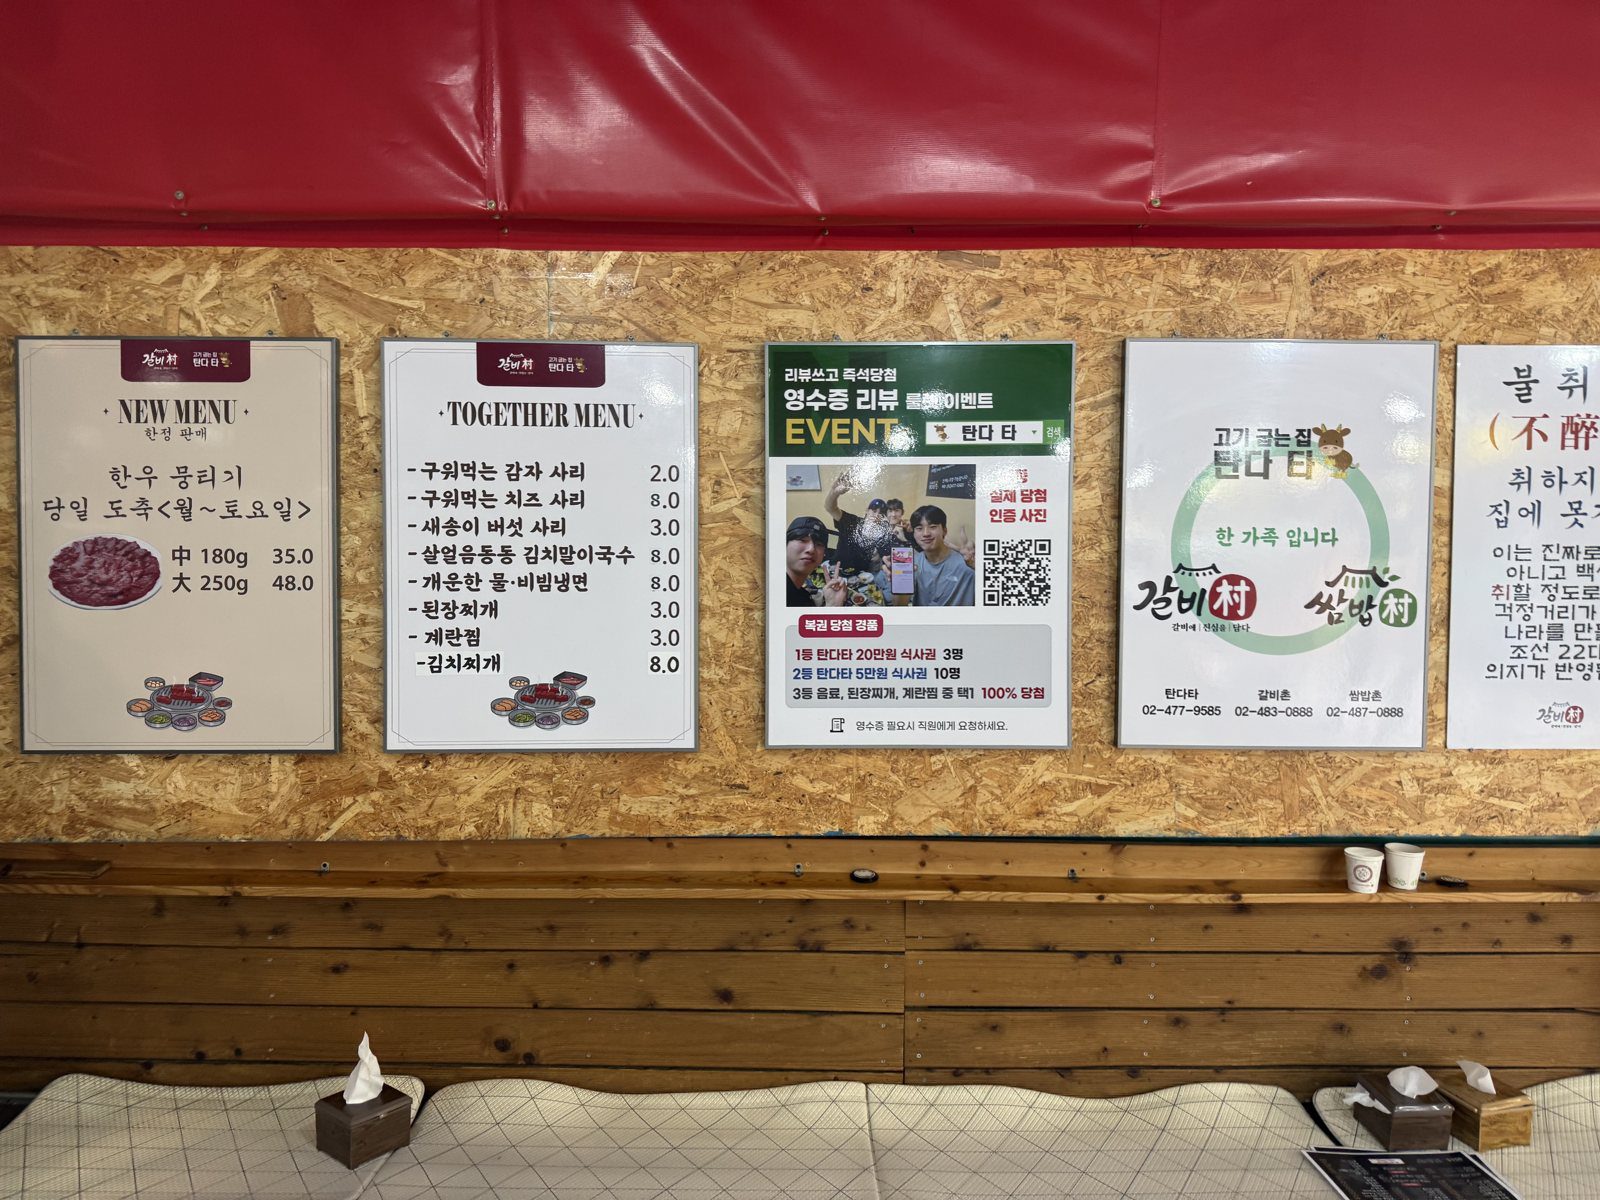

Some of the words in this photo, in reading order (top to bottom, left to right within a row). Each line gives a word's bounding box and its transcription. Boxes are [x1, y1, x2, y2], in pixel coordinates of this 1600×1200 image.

[784, 368, 839, 382] 리뷰쓰고
[843, 368, 897, 382] 즉석당첨
[783, 389, 849, 411] 영수증
[856, 389, 899, 411] 리뷰
[944, 393, 993, 410] 이벤트
[117, 400, 169, 424] NEW
[174, 400, 237, 424] MENU
[447, 401, 570, 427] TOGETHER
[574, 403, 637, 428] MENU
[145, 427, 172, 441] 한정
[179, 427, 207, 441] 판매
[786, 418, 899, 444] EVENT
[962, 424, 994, 441] 탄다
[1001, 424, 1017, 441] 타
[1213, 428, 1249, 447] 고기
[1256, 428, 1291, 447] 굽는
[1295, 428, 1311, 447] 집
[109, 465, 158, 490] 한우
[169, 465, 243, 490] 뭉티기
[505, 461, 543, 482] 감자
[549, 461, 585, 482] 사리
[650, 465, 680, 482] 2.0
[1508, 466, 1595, 496] 취하지
[504, 489, 543, 509] 치즈
[549, 489, 585, 509] 사리
[650, 492, 680, 509] 8.0
[990, 489, 1016, 503] 실제
[1020, 489, 1047, 503] 당첨
[43, 497, 88, 522] 당일
[989, 509, 1016, 523] 인증
[1020, 509, 1047, 523] 사진
[1486, 499, 1541, 529] 집에
[1560, 500, 1600, 529] 못
[487, 516, 524, 537] 버섯
[530, 516, 566, 537] 사리
[650, 519, 680, 536] 3.0
[1216, 527, 1234, 547] 한
[1241, 527, 1279, 547] 가족
[1286, 527, 1339, 547] 입니다
[172, 546, 191, 566] 中
[201, 548, 248, 568] 180g
[272, 548, 313, 565] 35.0
[523, 544, 636, 565] 김치말이국수
[650, 548, 680, 565] 8.0
[1493, 544, 1532, 561] 이는
[1542, 543, 1600, 561] 진짜로
[1506, 564, 1566, 581] 아니고
[1576, 563, 1600, 582] 백
[172, 573, 192, 593] 大
[200, 575, 248, 595] 250g
[272, 575, 314, 591] 48.0
[651, 575, 680, 591] 8.0
[1491, 583, 1531, 601] 취할
[1541, 583, 1600, 602] 정도로
[650, 602, 680, 618] 3.0
[1495, 604, 1597, 621] 걱정거리가
[804, 619, 827, 632] 복권
[830, 619, 853, 632] 당첨
[855, 619, 878, 632] 경품
[1505, 623, 1564, 641] 나라를
[650, 630, 680, 646] 3.0
[795, 648, 813, 661] 1등
[816, 648, 853, 661] 탄다타
[856, 648, 897, 661] 20만원
[900, 648, 937, 661] 식사권
[943, 648, 964, 661] 3명
[1510, 643, 1549, 661] 조선
[649, 656, 680, 673] 8.0
[792, 667, 813, 680] 2등
[816, 667, 853, 680] 탄다타
[855, 667, 888, 680] 5만원
[891, 667, 927, 680] 식사권
[934, 667, 961, 680] 10명
[1485, 663, 1545, 680] 의지가
[1555, 662, 1600, 681] 반영
[792, 687, 813, 700] 3등
[816, 687, 844, 700] 음료,
[847, 687, 899, 700] 된장찌개,
[902, 687, 938, 700] 계란찜
[941, 687, 954, 700] 중
[957, 687, 974, 700] 택1
[981, 687, 1017, 699] 100%
[1020, 687, 1045, 699] 당첨
[1165, 688, 1199, 700] 탄다타
[1258, 689, 1291, 701] 갈비촌
[1349, 690, 1382, 701] 쌈밥촌
[1142, 705, 1221, 716] 02-477-9585
[1235, 707, 1313, 717] 02-483-0888
[1326, 707, 1403, 718] 02-487-0888
[856, 721, 884, 732] 영수증
[887, 721, 915, 732] 필요시
[918, 721, 955, 732] 직원에게
[958, 721, 1008, 732] 요청하세요.
